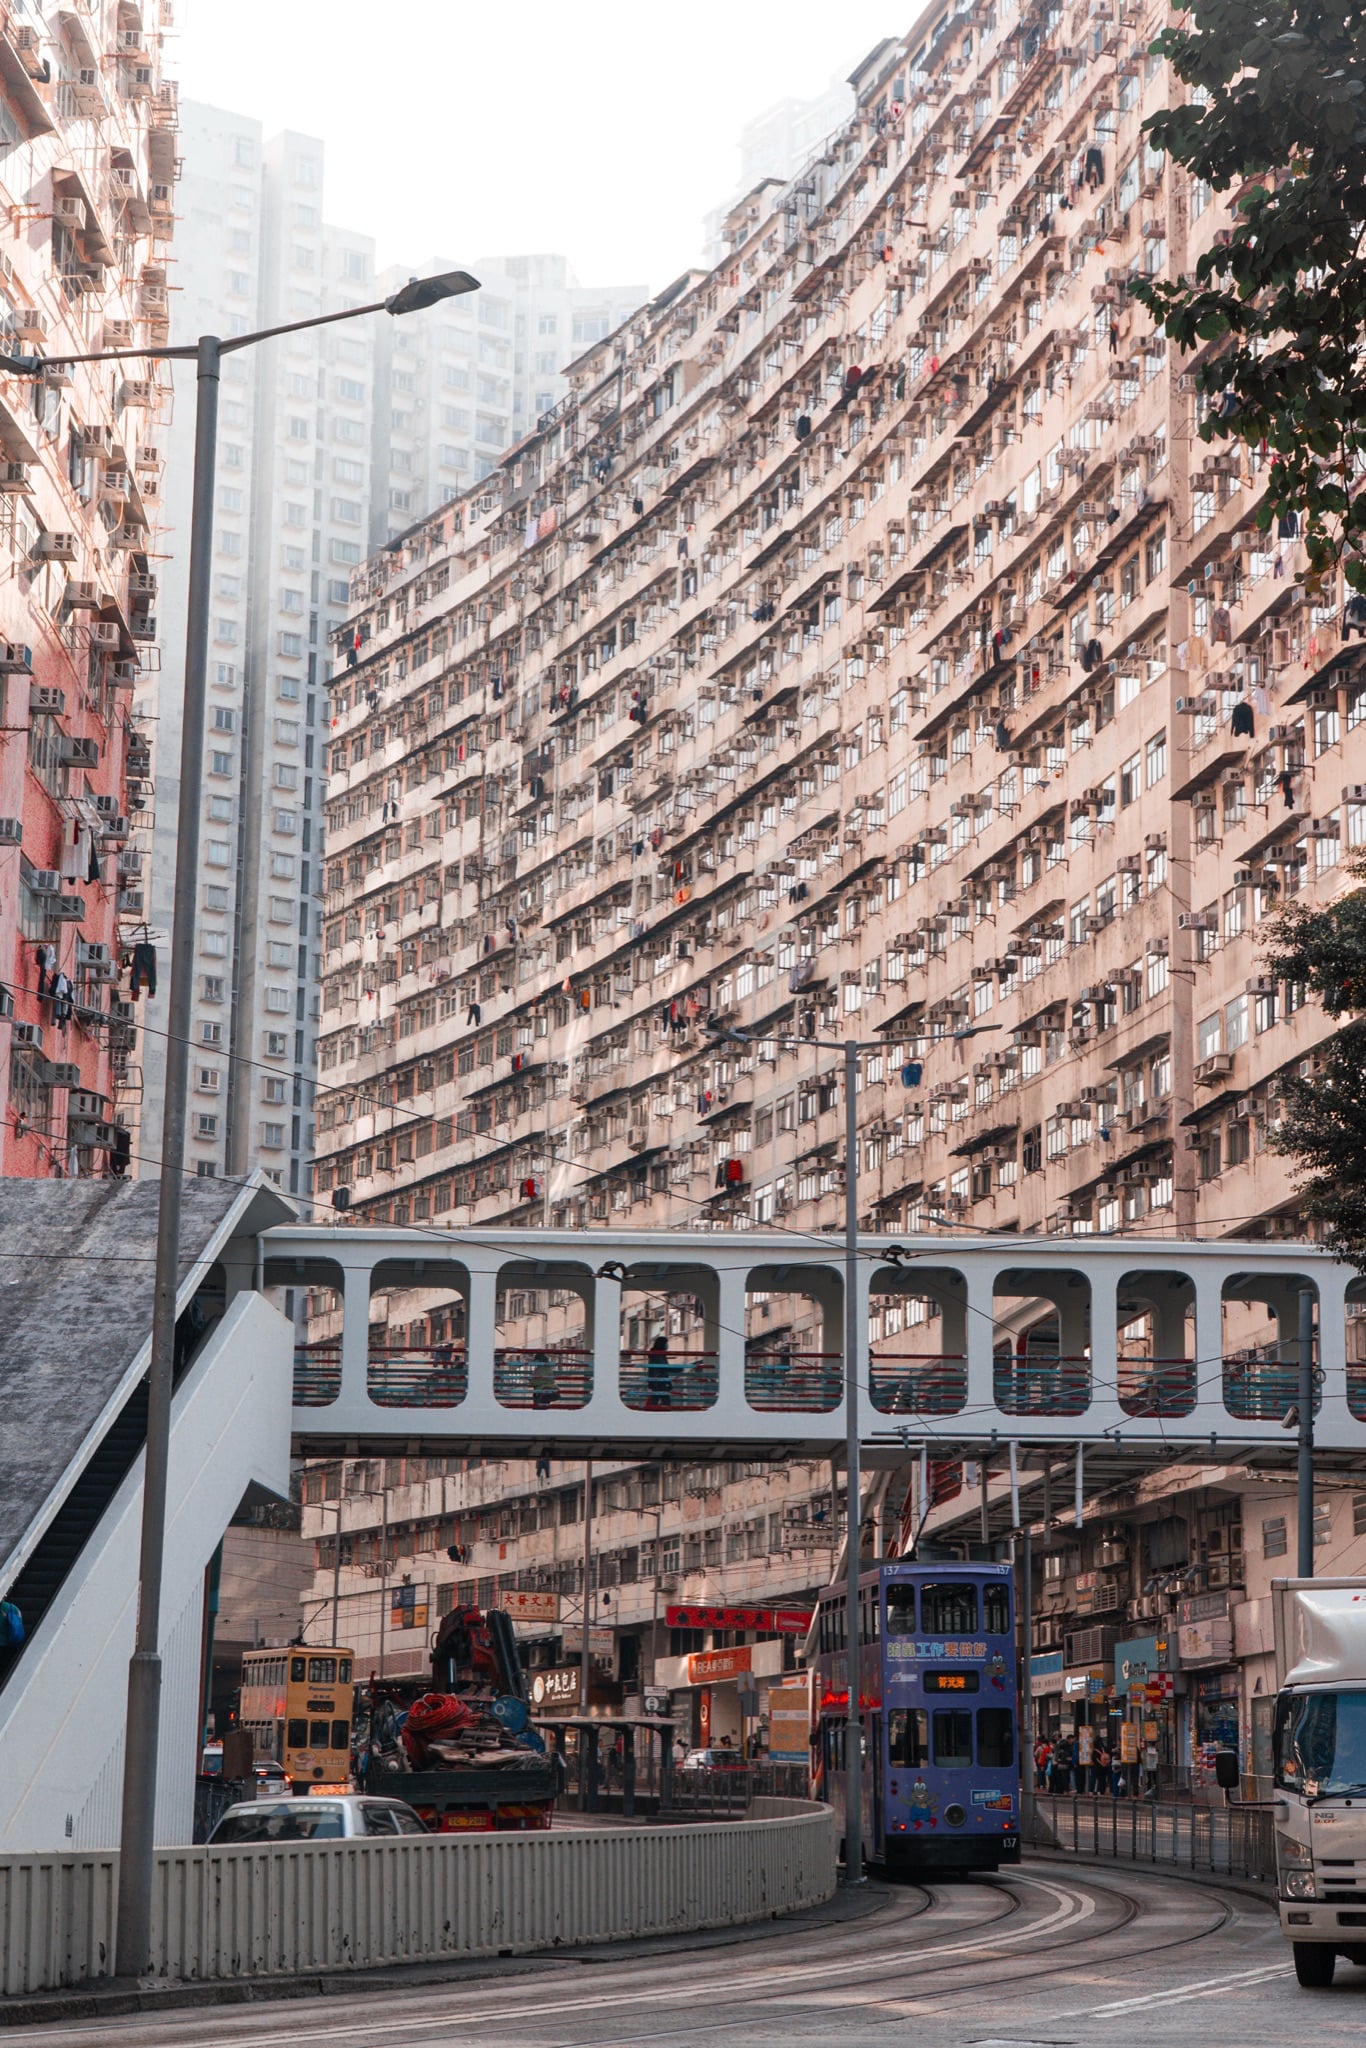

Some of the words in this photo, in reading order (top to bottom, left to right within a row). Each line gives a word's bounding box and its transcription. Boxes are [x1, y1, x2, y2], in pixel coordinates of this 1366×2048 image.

[884, 1565, 900, 1576] 137
[996, 1565, 1010, 1575] 137
[1003, 1837, 1016, 1848] 137
